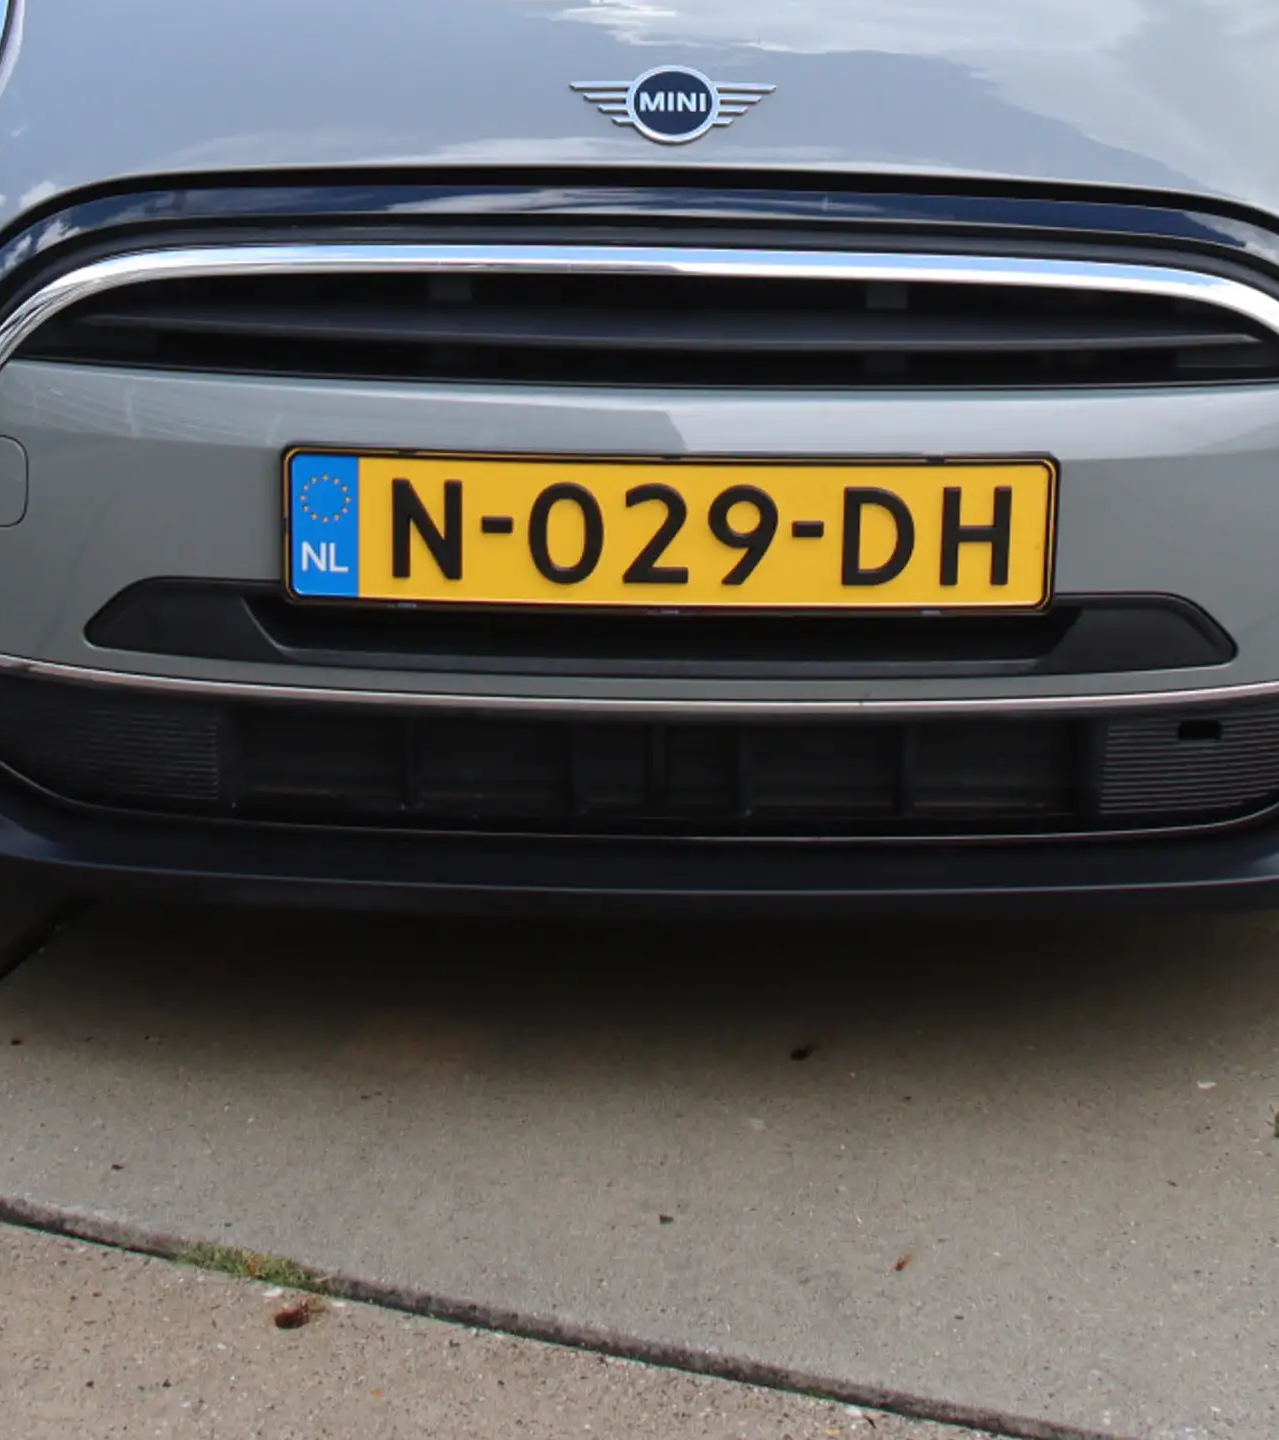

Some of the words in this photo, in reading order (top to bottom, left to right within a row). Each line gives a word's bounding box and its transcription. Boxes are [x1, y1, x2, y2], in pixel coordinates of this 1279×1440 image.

[639, 91, 707, 112] MINI
[390, 477, 1013, 587] N-029-DH
[301, 541, 349, 573] NL
